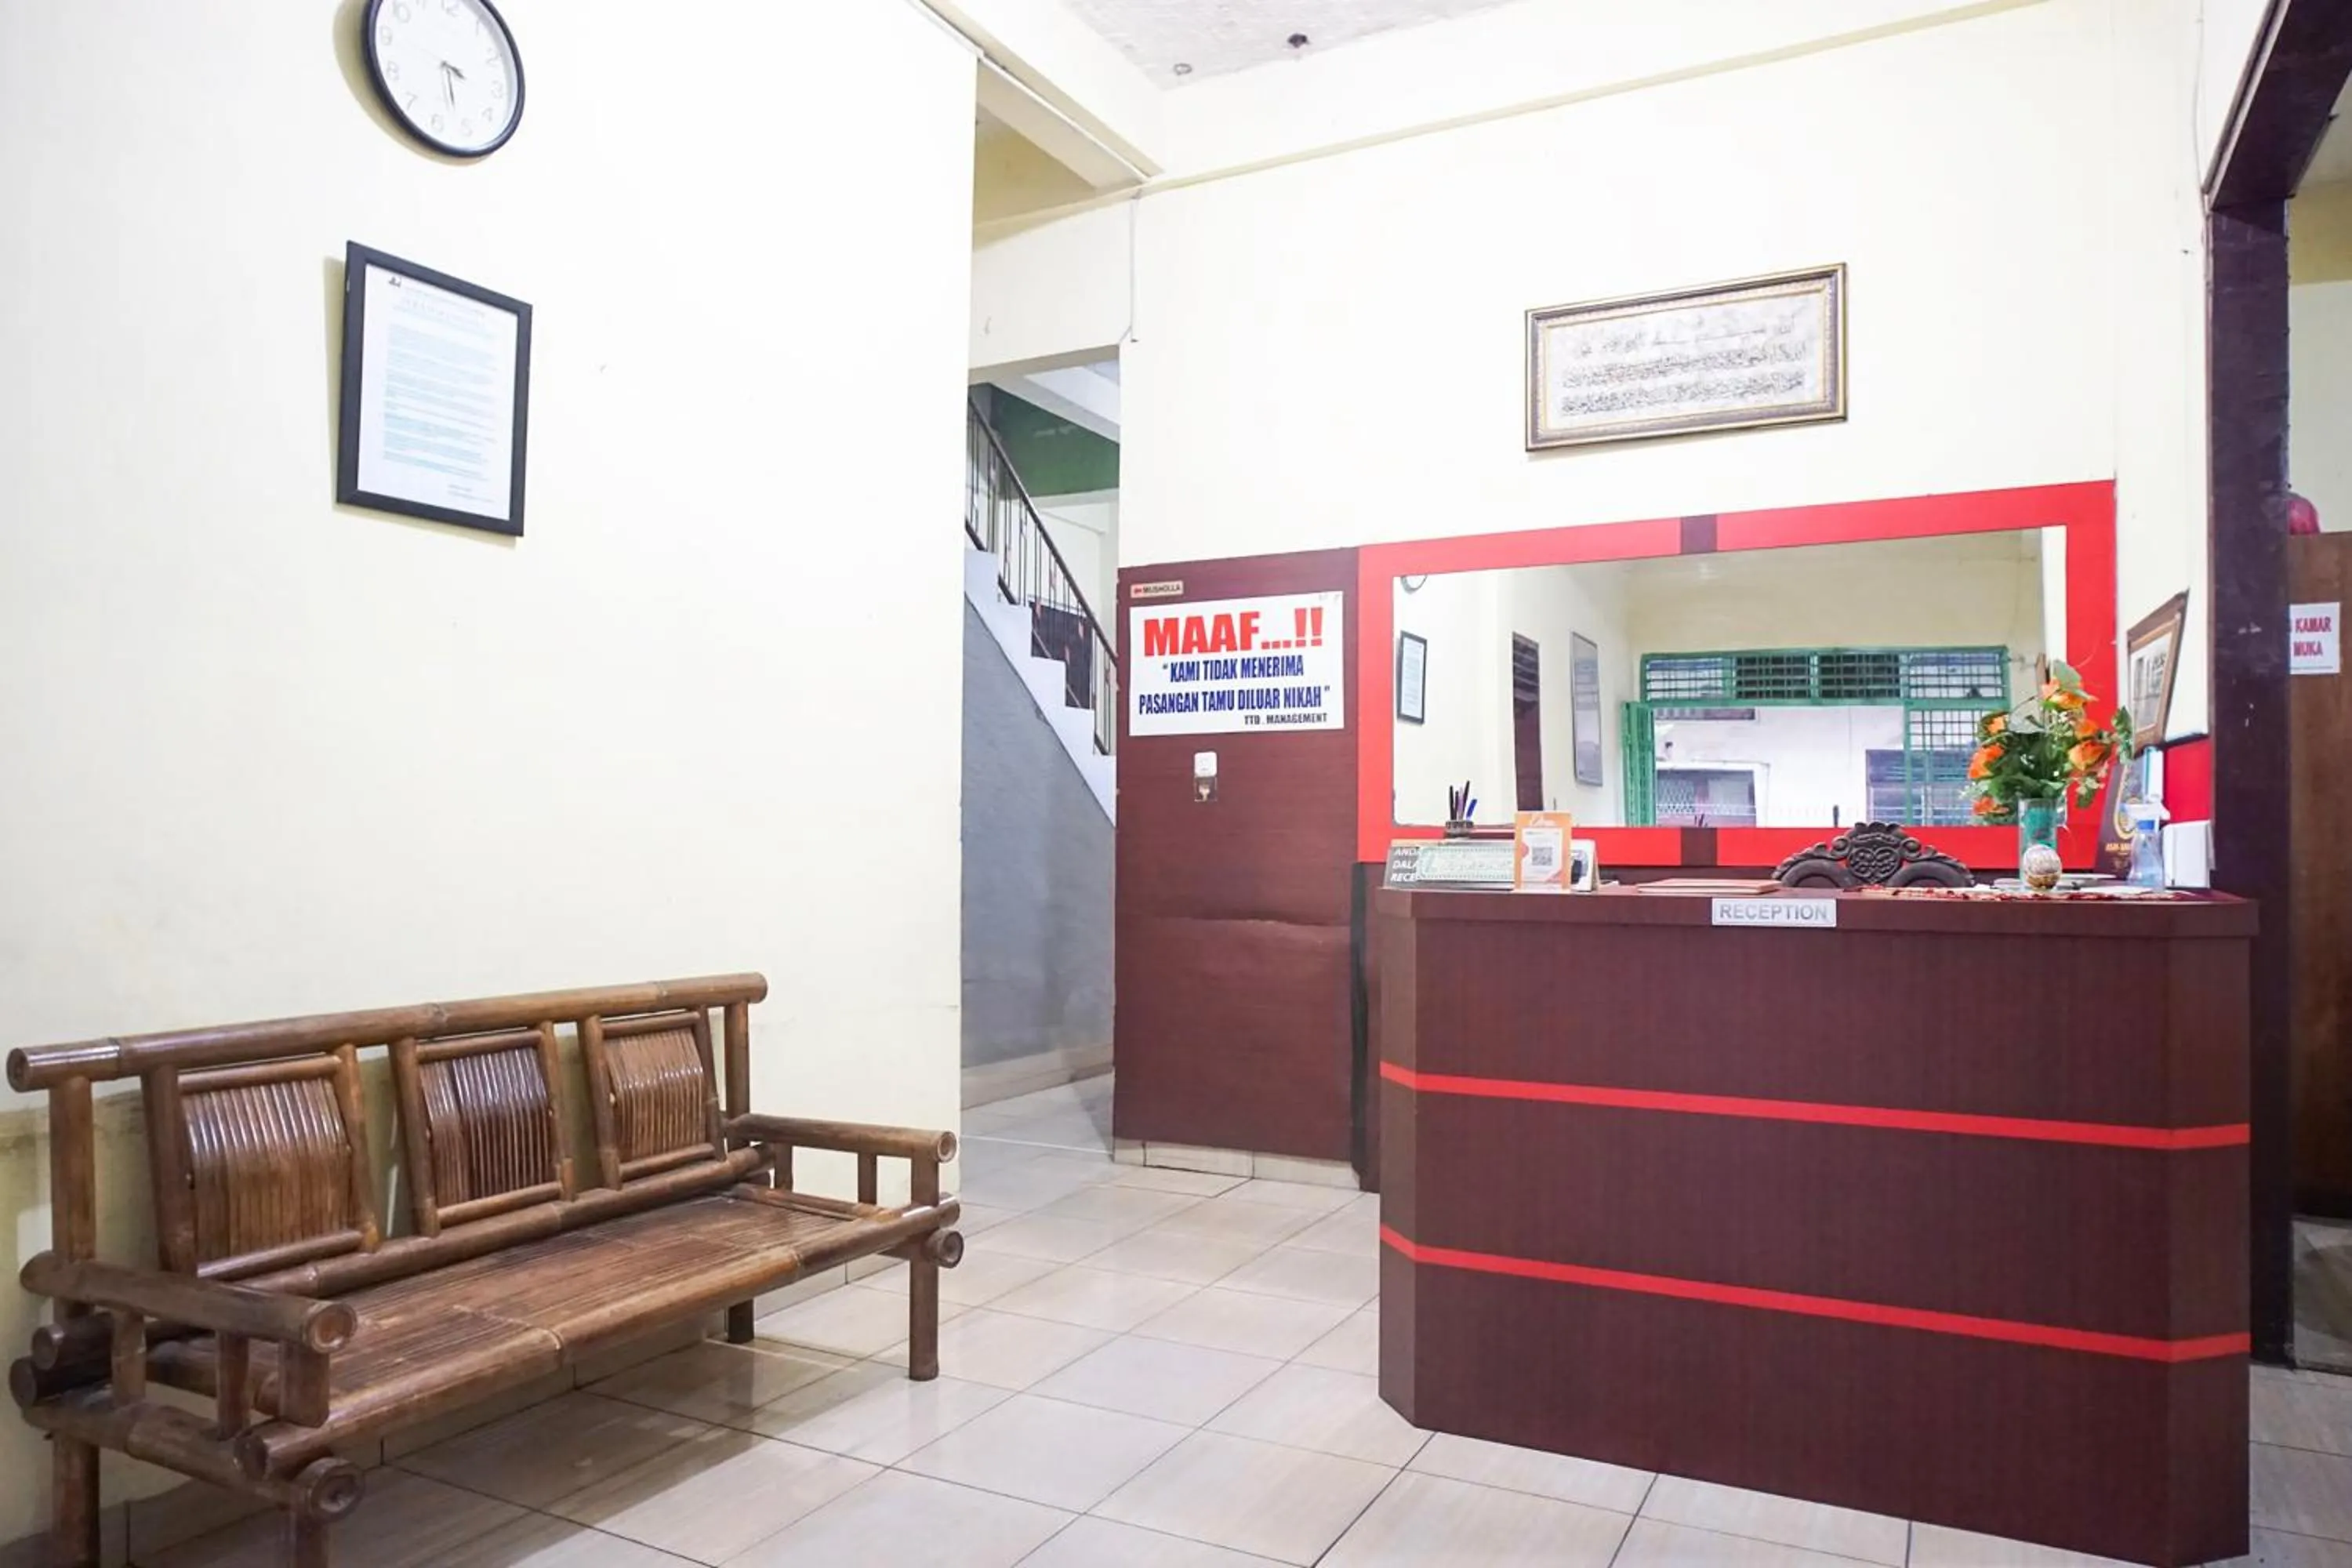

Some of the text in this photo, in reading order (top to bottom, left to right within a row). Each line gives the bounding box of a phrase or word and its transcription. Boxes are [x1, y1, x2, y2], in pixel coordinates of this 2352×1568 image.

[2295, 616, 2332, 633] KAMAR
[1203, 658, 1238, 681] TIDAK
[1241, 655, 1304, 680] MENERIMA
[1139, 692, 1199, 715] PASANGAN
[1202, 690, 1235, 712] TAMU
[1238, 688, 1280, 710] DILUAR
[1267, 713, 1327, 724] MANAGEMENT
[1719, 904, 1828, 920] RECEPTION
